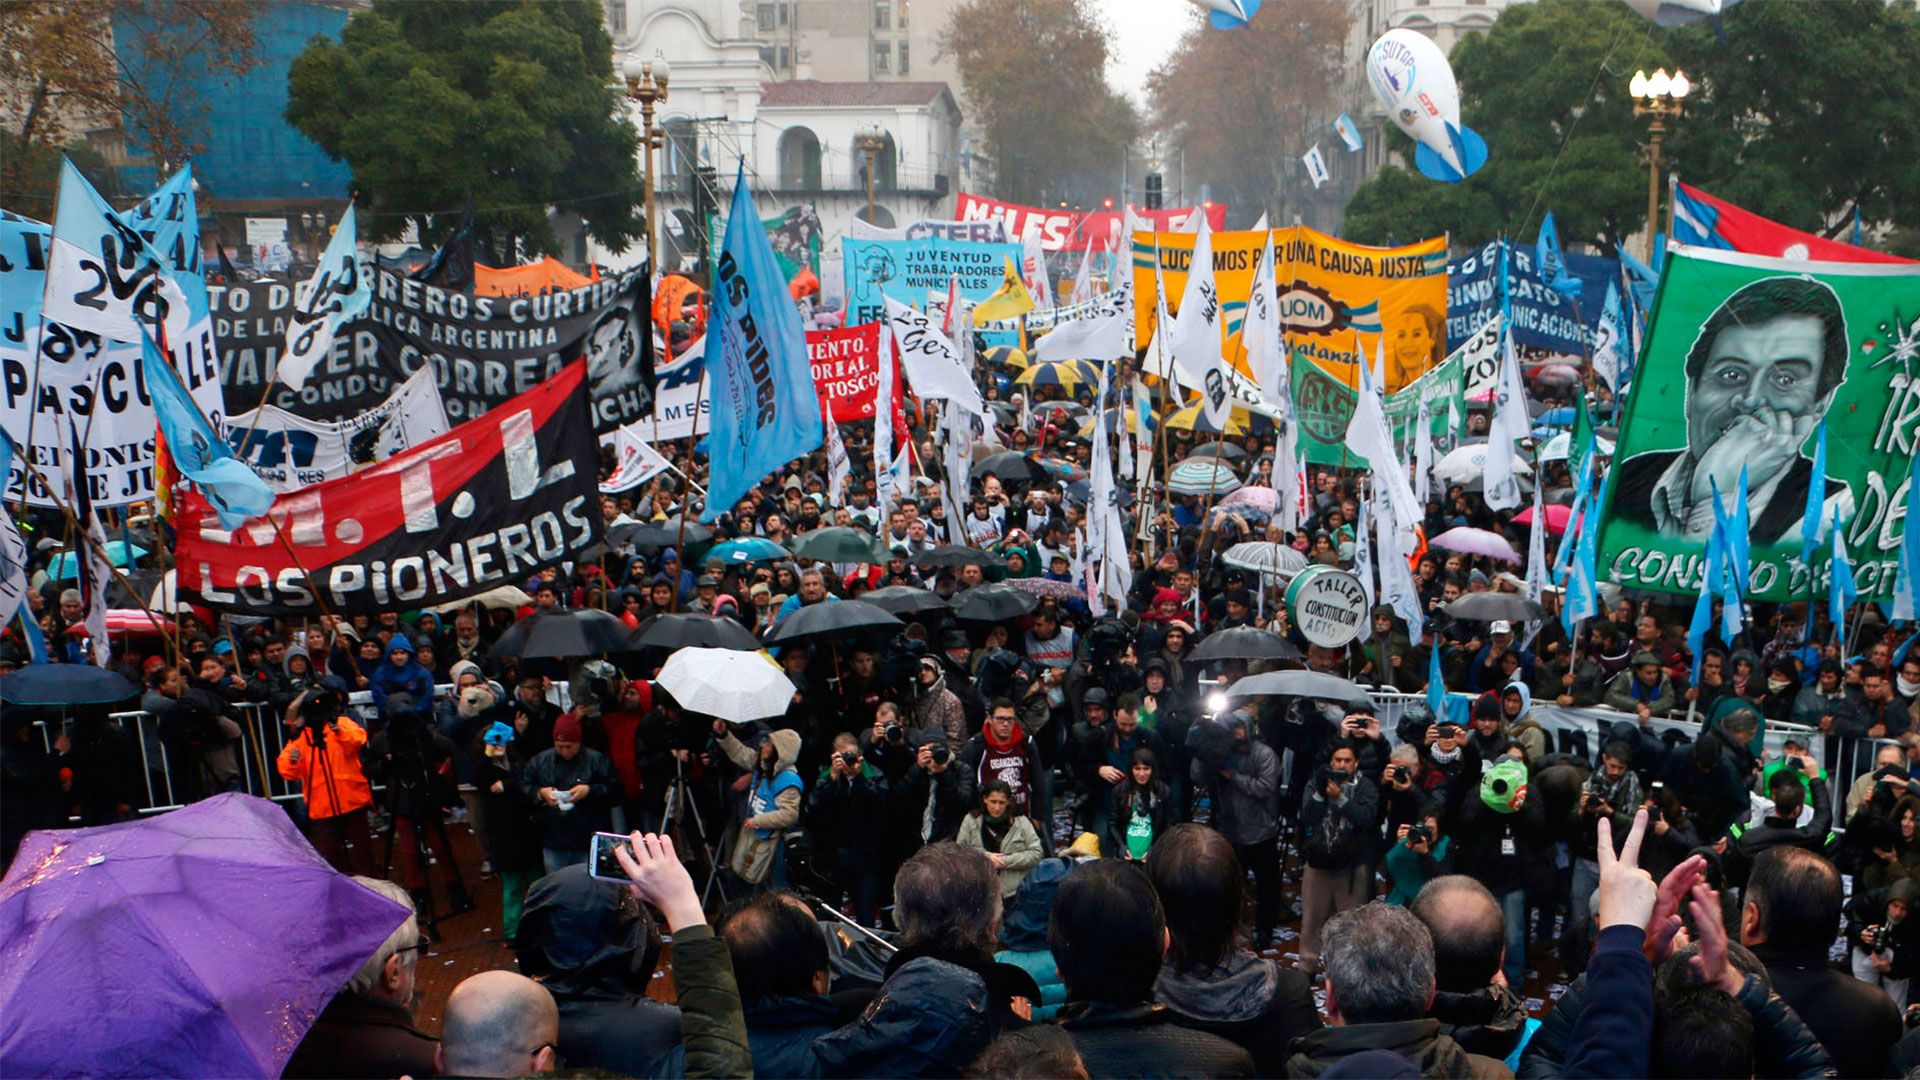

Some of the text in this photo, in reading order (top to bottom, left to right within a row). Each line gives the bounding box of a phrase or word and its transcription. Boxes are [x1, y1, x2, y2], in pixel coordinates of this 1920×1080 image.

[906, 251, 992, 264] JUVENTUD
[906, 264, 1005, 277] TRABAJADORES
[1286, 240, 1317, 266] UNA
[1320, 247, 1374, 277] CAUSA
[1279, 297, 1326, 321] UOM
[430, 324, 558, 350] ARGENTINA
[200, 562, 315, 607] LOS
[1314, 579, 1363, 608] TALLER
